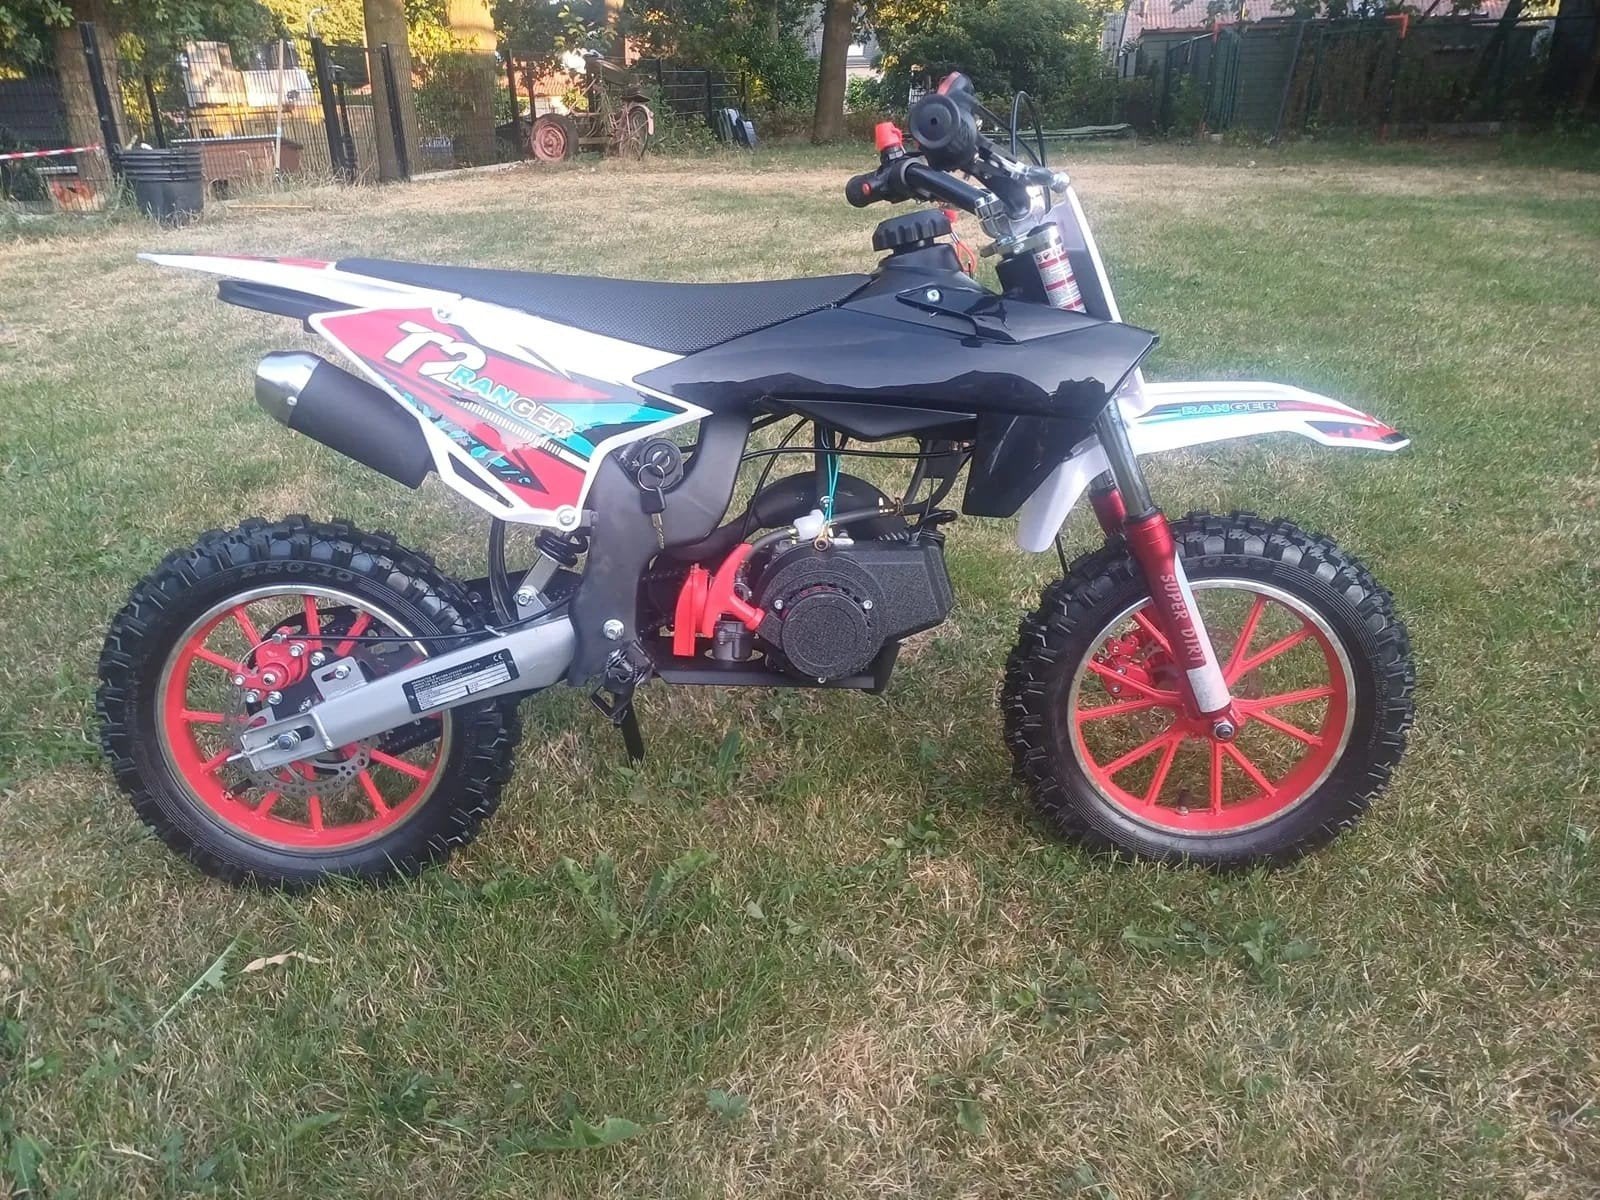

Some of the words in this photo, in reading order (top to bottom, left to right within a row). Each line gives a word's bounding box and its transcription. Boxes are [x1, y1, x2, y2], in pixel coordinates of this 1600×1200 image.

[384, 320, 487, 391] T2
[449, 364, 576, 438] RANGER
[1181, 401, 1279, 416] RANGER
[1160, 574, 1188, 620] SUPER
[1180, 628, 1206, 666] DIRT
